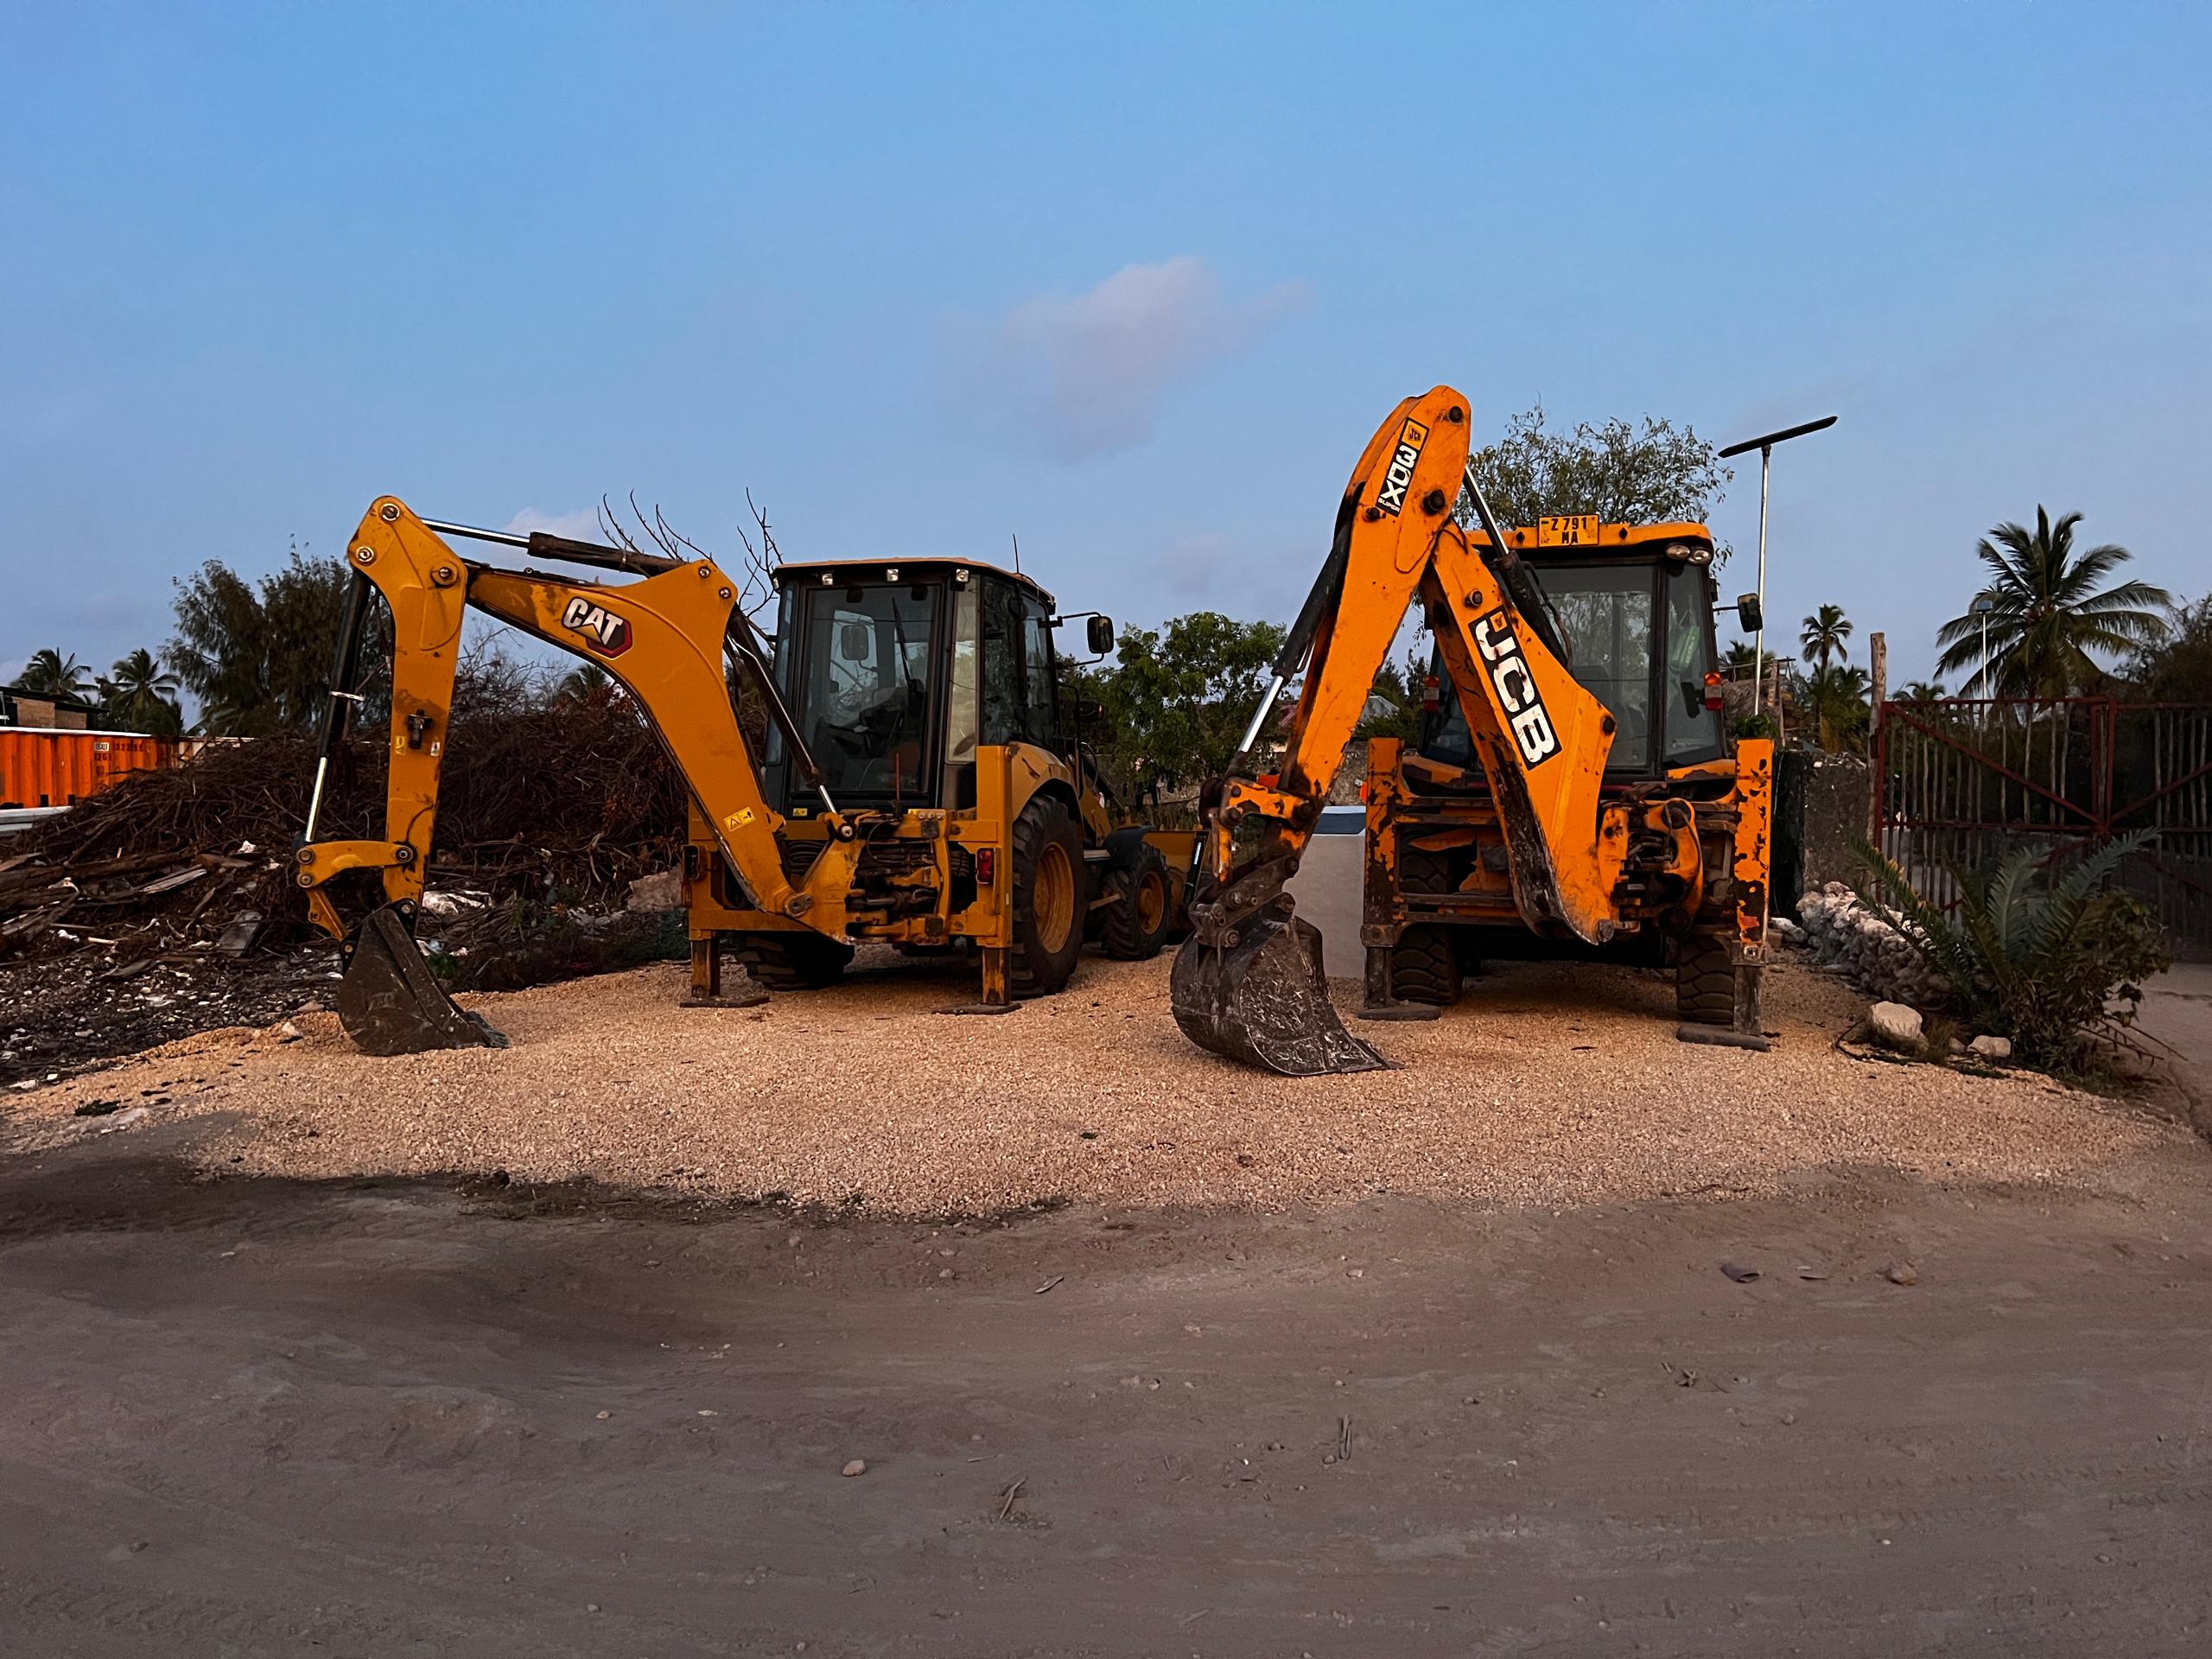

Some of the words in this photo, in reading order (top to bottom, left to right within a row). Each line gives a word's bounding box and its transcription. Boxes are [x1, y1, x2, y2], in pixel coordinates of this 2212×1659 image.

[1379, 444, 1418, 507] 3DX
[1377, 497, 1401, 512] SUPER
[1550, 518, 1559, 531] Z
[1562, 516, 1587, 531] 791
[1561, 531, 1579, 544] MA
[563, 597, 624, 645] CAT
[1475, 620, 1555, 763] JCB
